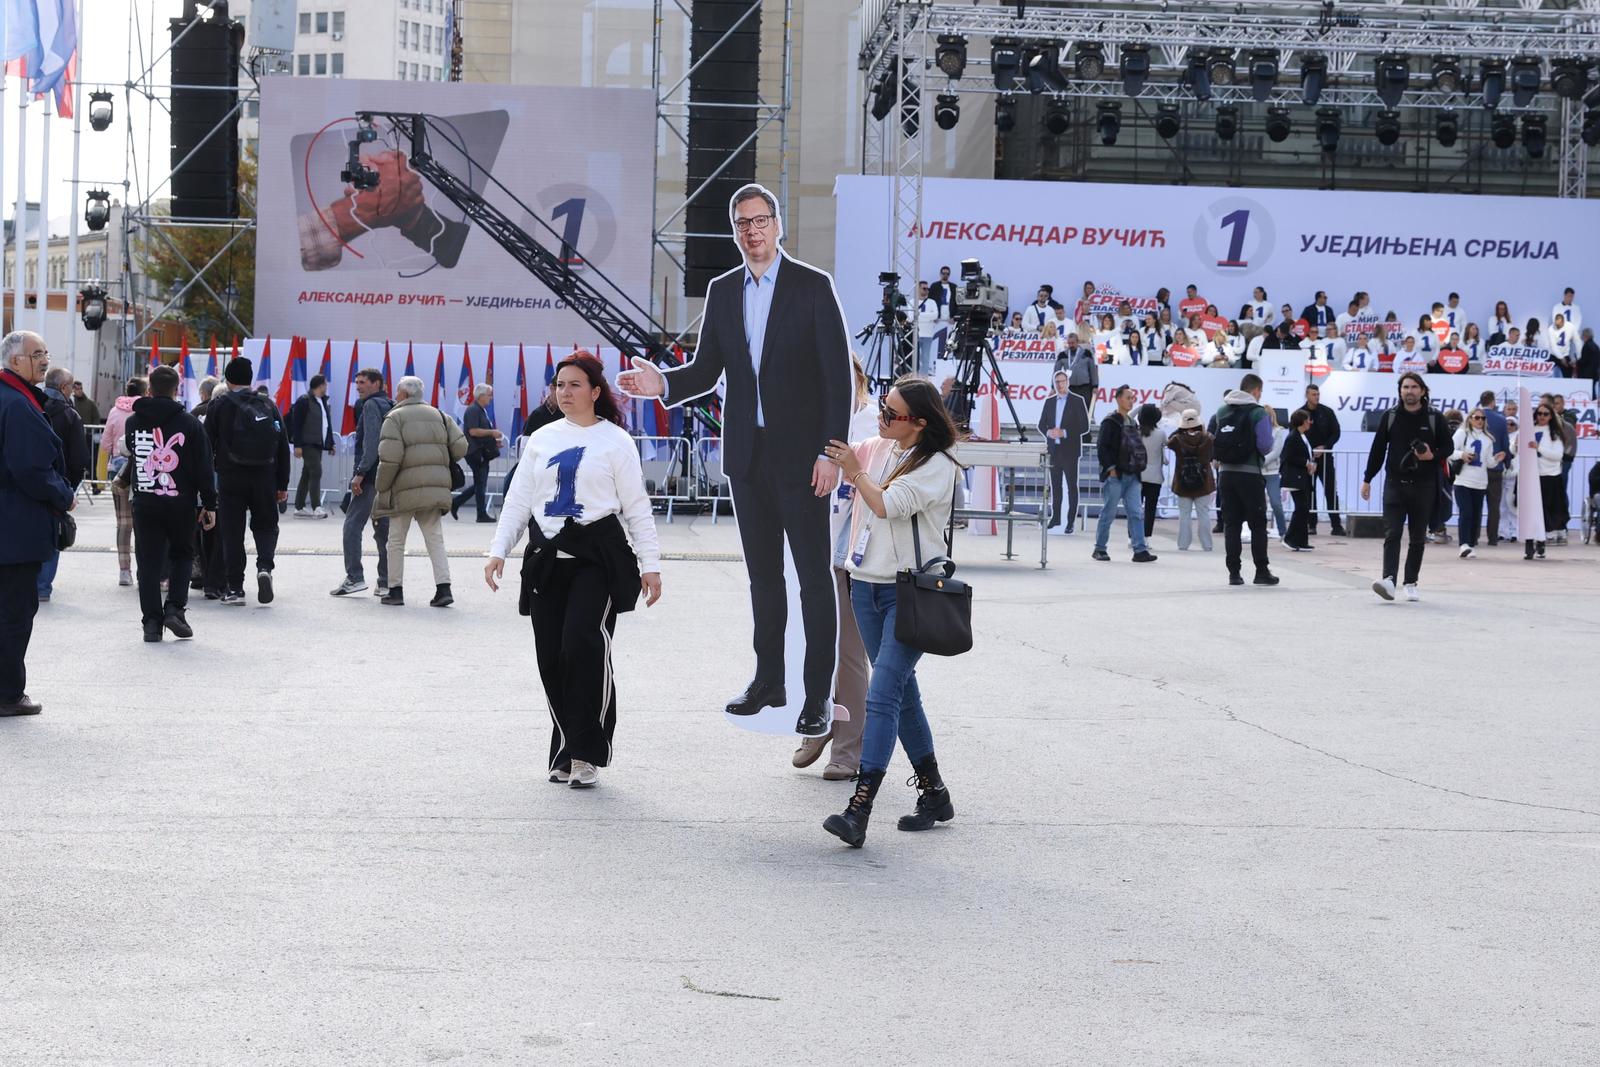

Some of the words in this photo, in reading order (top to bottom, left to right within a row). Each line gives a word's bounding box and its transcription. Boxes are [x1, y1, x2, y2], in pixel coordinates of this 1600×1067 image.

[551, 198, 586, 269] 1
[907, 220, 1078, 247] АЛЕКСАНДАР
[1081, 227, 1167, 248] ВУЧИЋ
[1216, 209, 1250, 269] 1
[1300, 234, 1457, 258] УЈЕДИЊЕНА
[1464, 239, 1559, 260] СРБИЈА
[298, 291, 394, 305] АЛЕКСАНДАР
[398, 293, 446, 306] ВУЧИЋ
[466, 296, 551, 309] УЈЕДИЊЕНА
[1089, 294, 1157, 309] СРБИЈА
[1447, 312, 1456, 328] 1
[999, 340, 1056, 352] РАДА
[1147, 333, 1157, 350] 1
[1421, 336, 1432, 352] 1
[1557, 331, 1566, 347] 1
[1001, 351, 1057, 361] РЕЗУЛТАТА
[1325, 343, 1335, 360] 1
[1468, 344, 1479, 360] 1
[1490, 347, 1549, 359] ЗАЈЕДНО
[1356, 353, 1366, 368] 1
[1484, 360, 1501, 369] ЗА
[1504, 361, 1553, 372] СРБИЈУ
[135, 430, 154, 456] OFF
[1468, 440, 1483, 467] 1
[544, 446, 587, 518] 1
